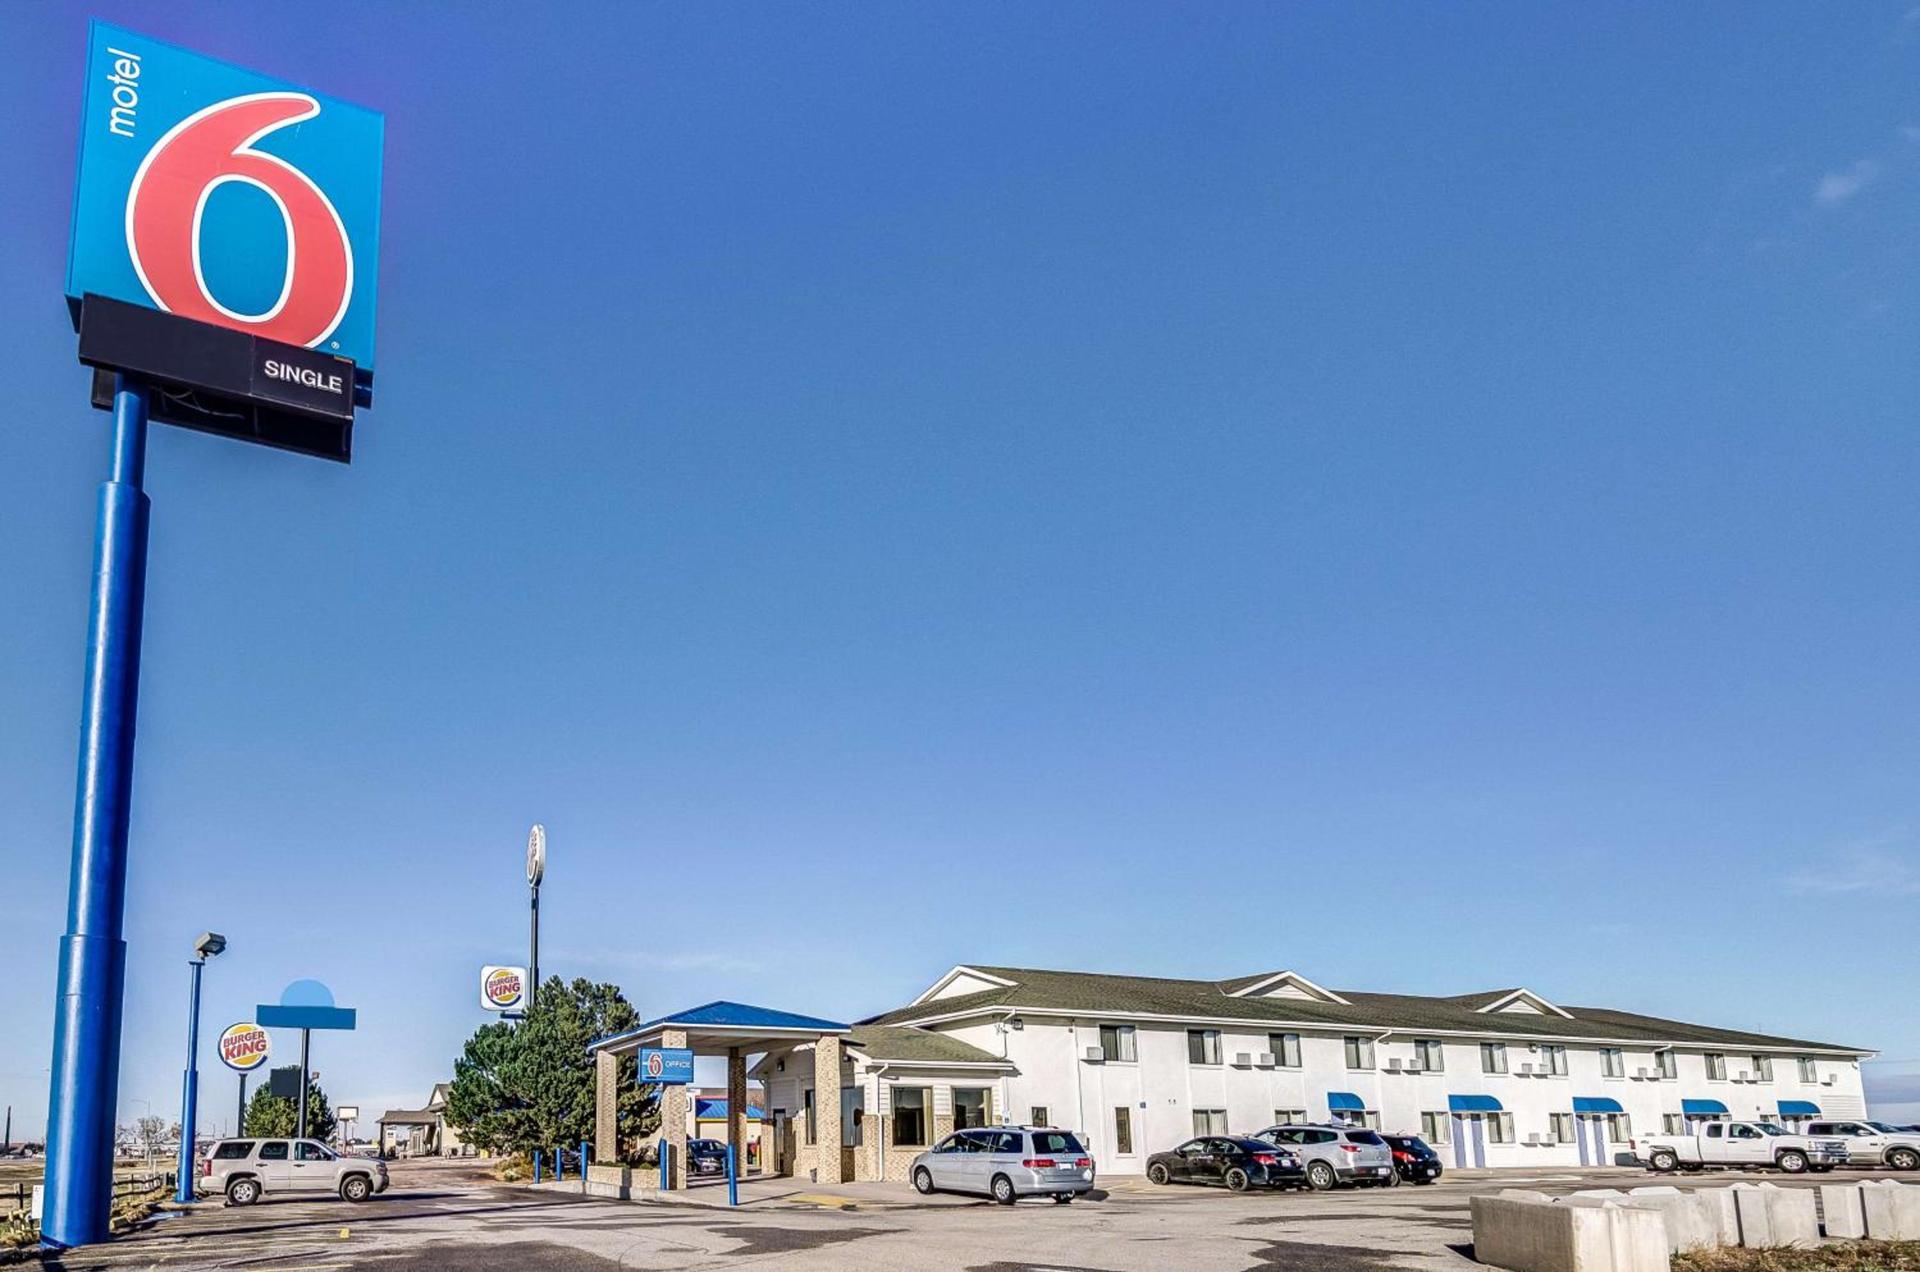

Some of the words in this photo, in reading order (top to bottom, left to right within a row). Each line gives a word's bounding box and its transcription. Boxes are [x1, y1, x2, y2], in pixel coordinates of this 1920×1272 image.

[107, 47, 141, 137] motel
[125, 91, 354, 349] 6
[264, 360, 343, 394] SINGLE
[489, 976, 519, 988] BURGER
[490, 983, 520, 998] KING
[223, 1031, 265, 1048] BURGER
[225, 1039, 267, 1060] KING
[648, 1051, 663, 1077] 6
